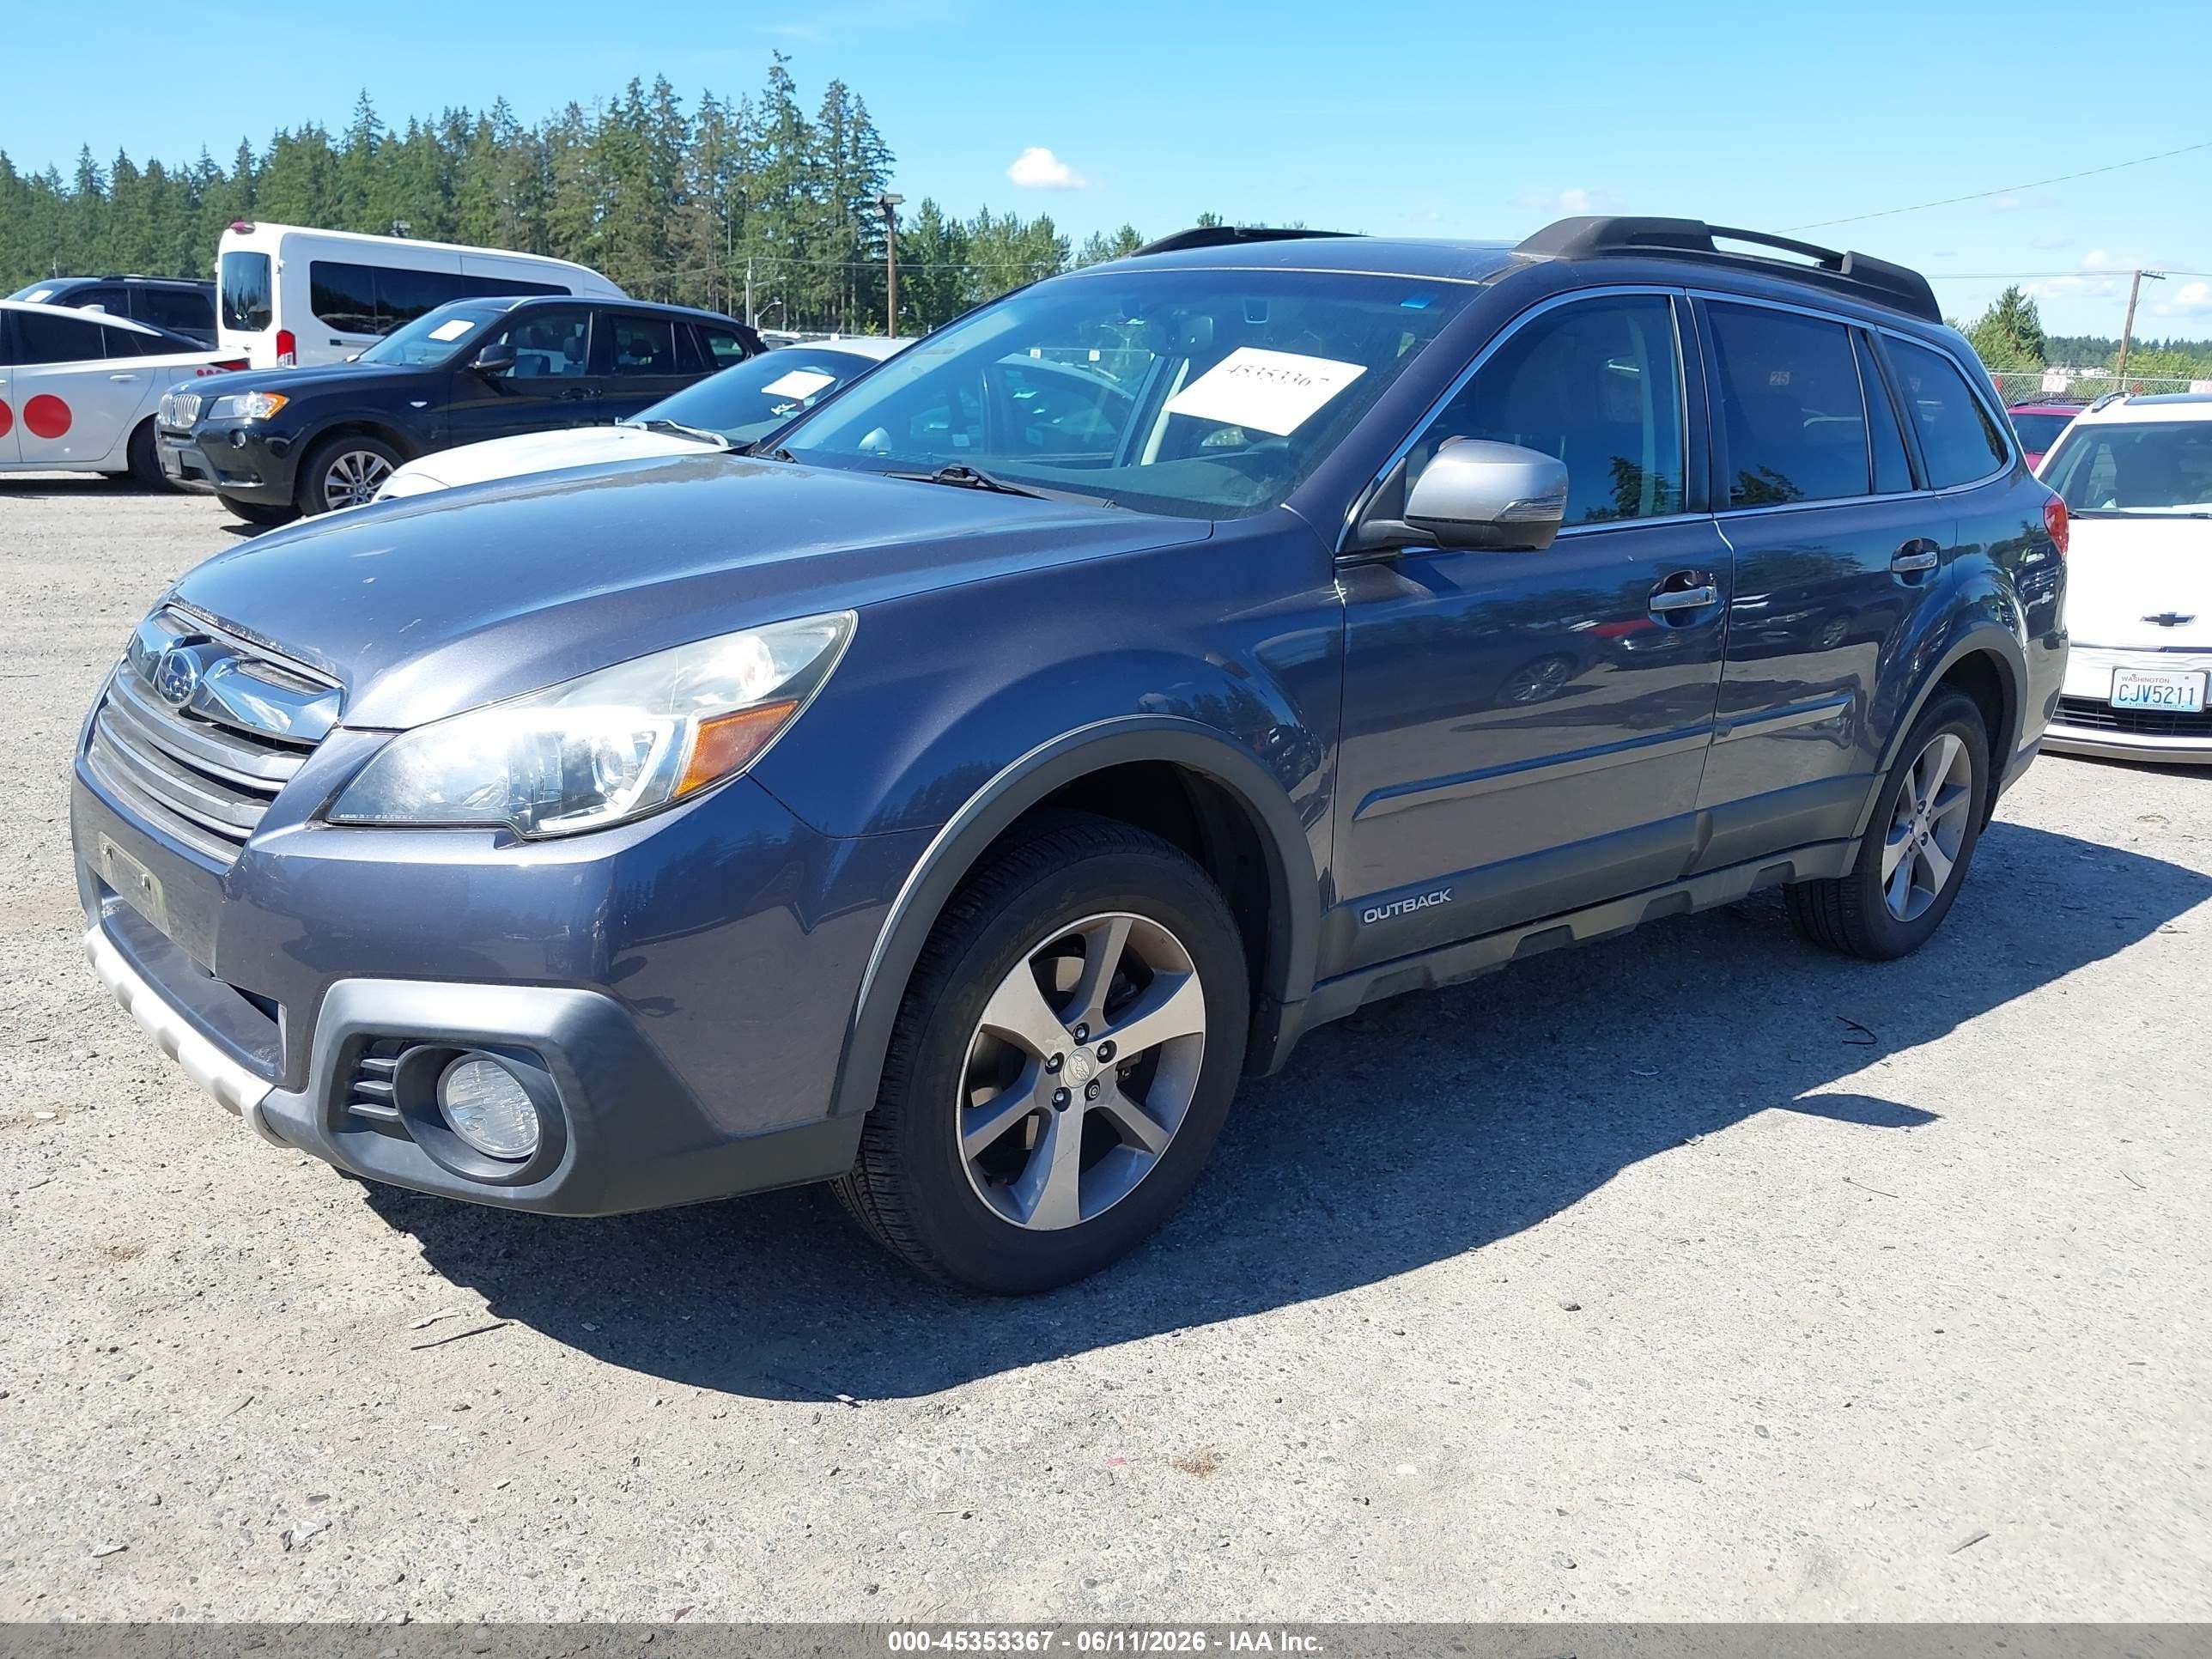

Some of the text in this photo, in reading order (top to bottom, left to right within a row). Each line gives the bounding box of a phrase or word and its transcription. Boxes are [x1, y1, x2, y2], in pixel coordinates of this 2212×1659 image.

[2045, 377, 2063, 391] 27
[2118, 684, 2194, 705] CJV5211
[1364, 888, 1452, 923] OUTBACK
